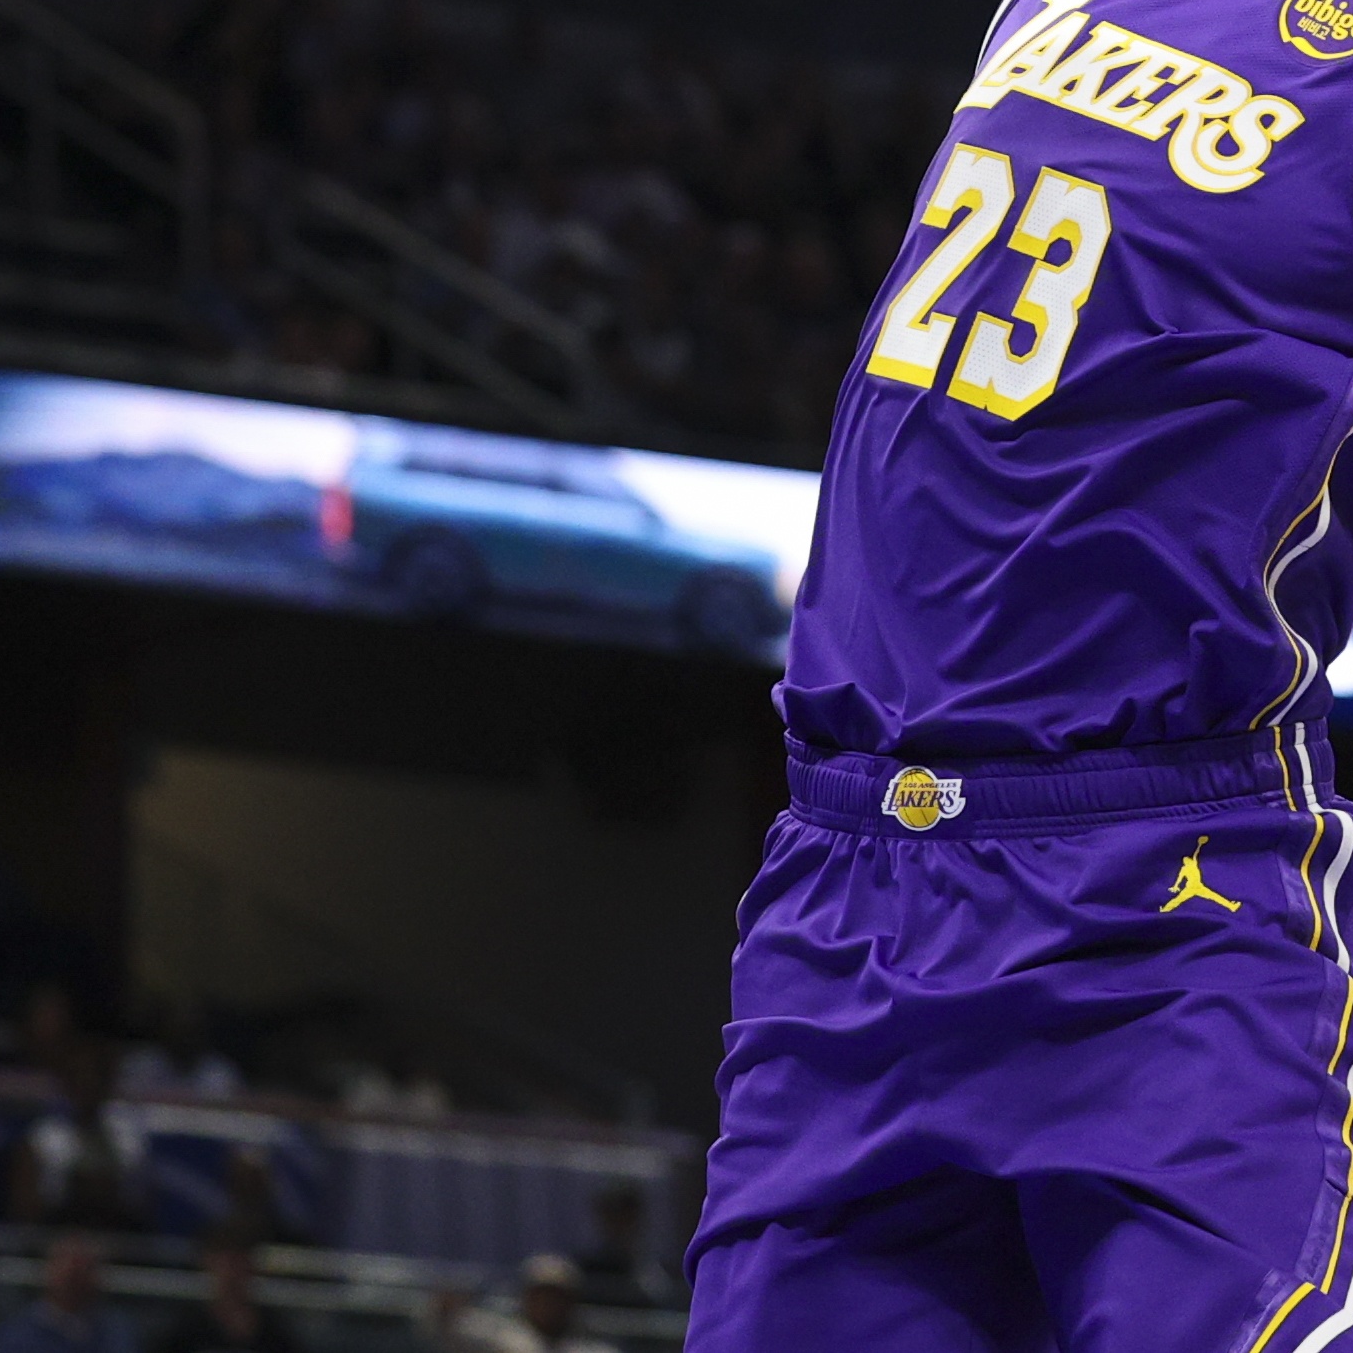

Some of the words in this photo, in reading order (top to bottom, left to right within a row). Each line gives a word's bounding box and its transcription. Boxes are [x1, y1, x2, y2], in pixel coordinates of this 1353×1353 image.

[866, 143, 1112, 422] 23
[884, 781, 962, 815] LAKERS
[918, 781, 958, 789] ANGELES
